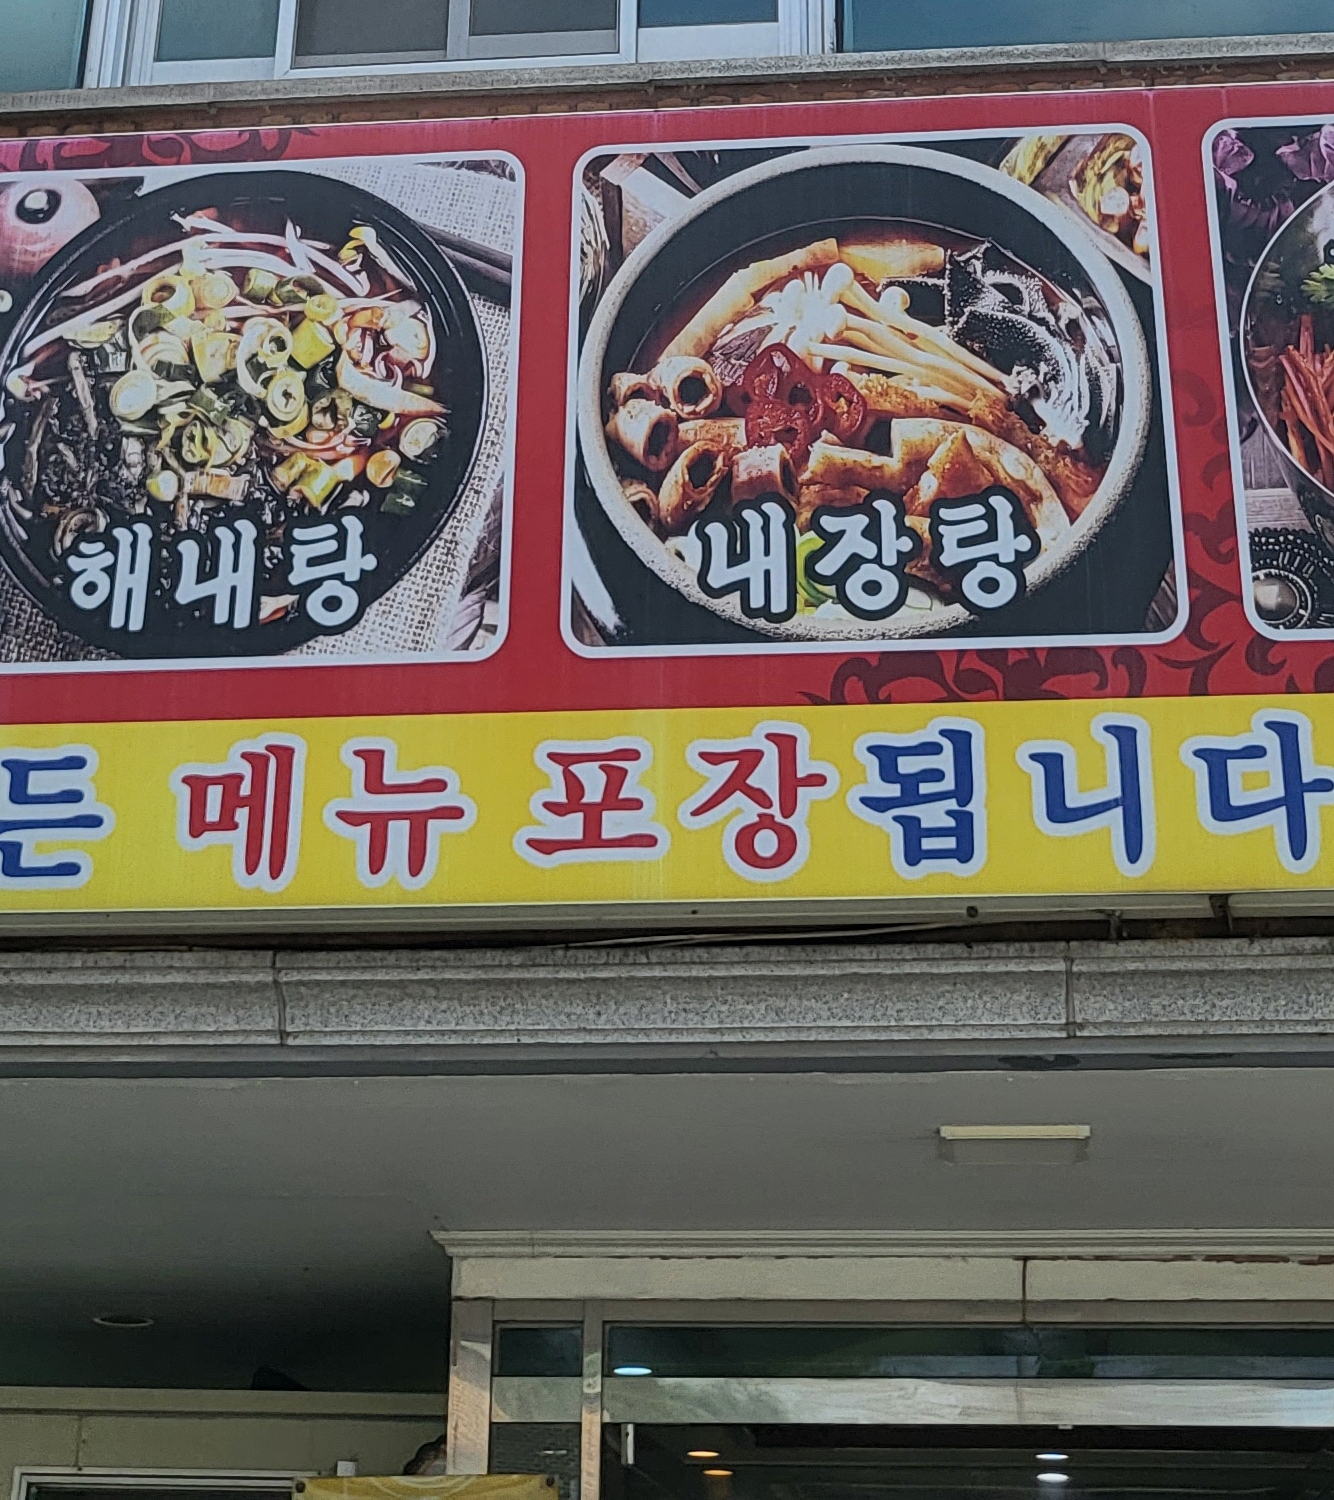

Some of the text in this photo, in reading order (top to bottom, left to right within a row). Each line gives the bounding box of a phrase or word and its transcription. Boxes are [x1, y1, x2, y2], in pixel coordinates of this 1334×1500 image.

[67, 516, 377, 634] 해내탕
[697, 495, 1039, 620] 내장탕
[181, 743, 467, 882] 메뉴
